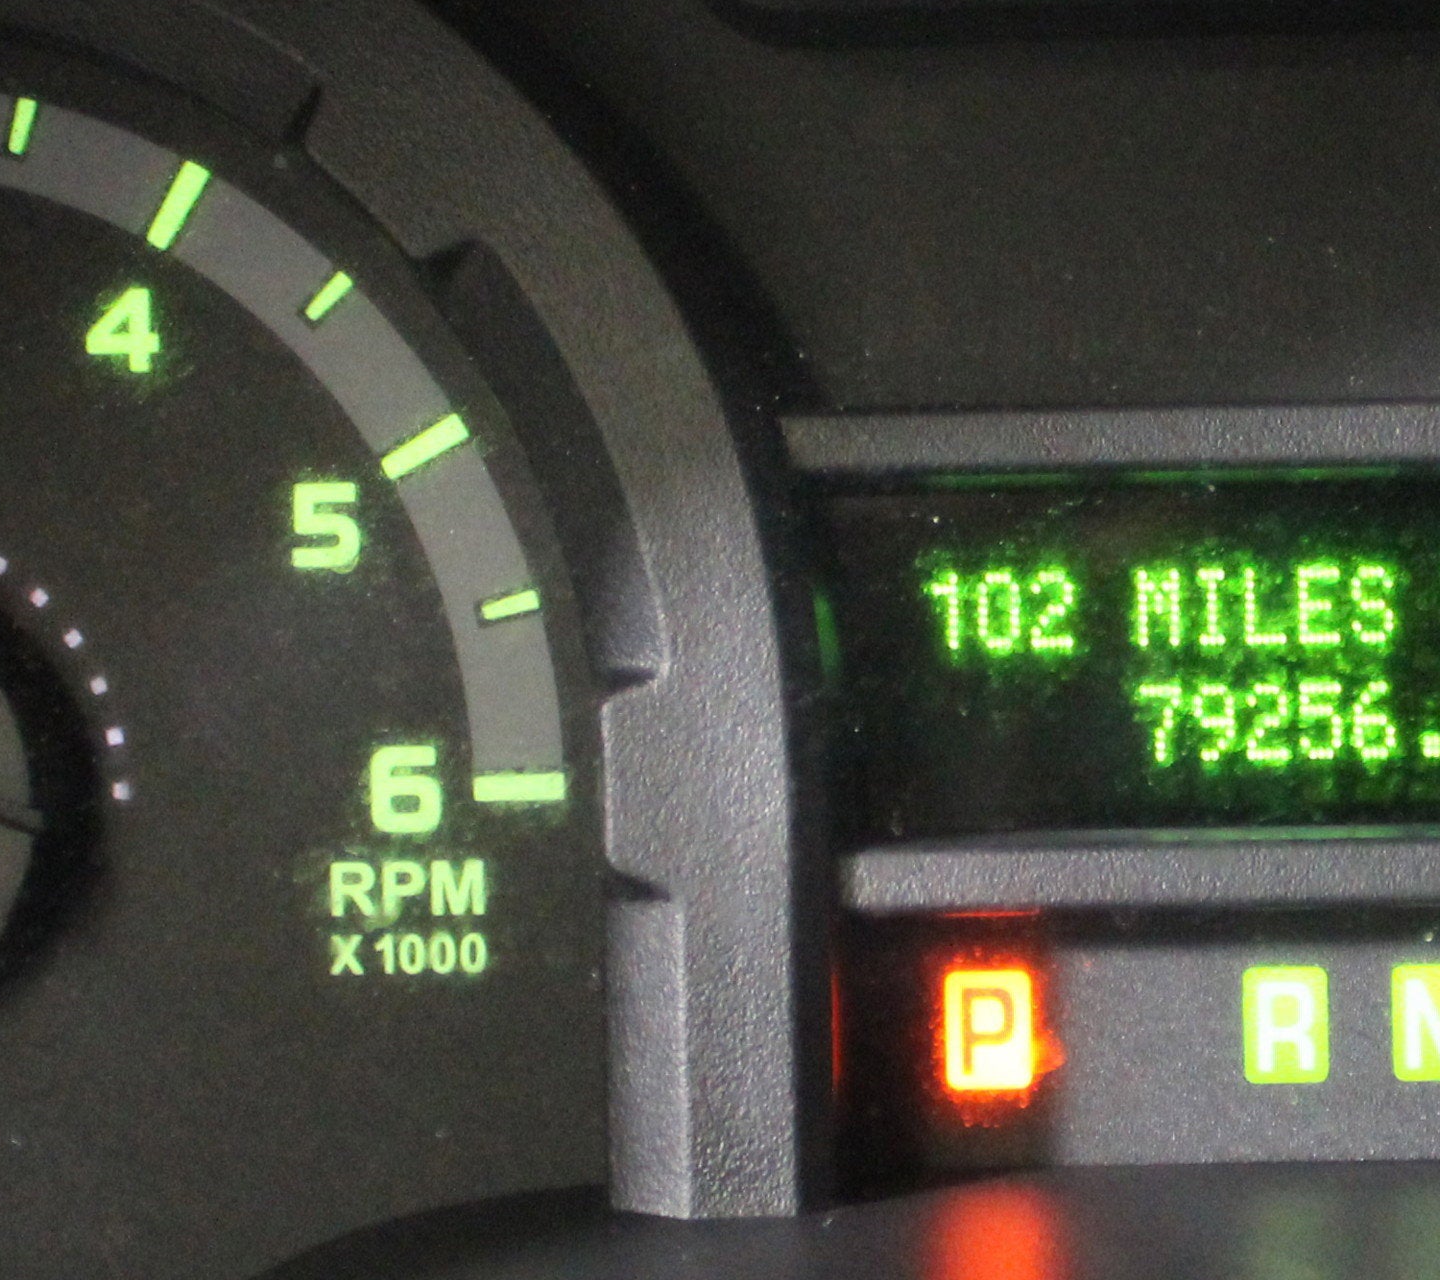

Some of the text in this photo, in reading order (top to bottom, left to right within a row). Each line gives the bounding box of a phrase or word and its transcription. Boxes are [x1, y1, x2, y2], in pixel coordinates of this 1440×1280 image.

[84, 285, 163, 375] 4
[290, 480, 364, 573] 5
[925, 563, 1080, 659] 102
[1133, 560, 1398, 654] MILES
[367, 743, 444, 836] 6
[329, 858, 487, 919] RPM
[330, 931, 489, 977] X 1000
[961, 987, 1014, 1076] P
[1256, 980, 1317, 1074] R
